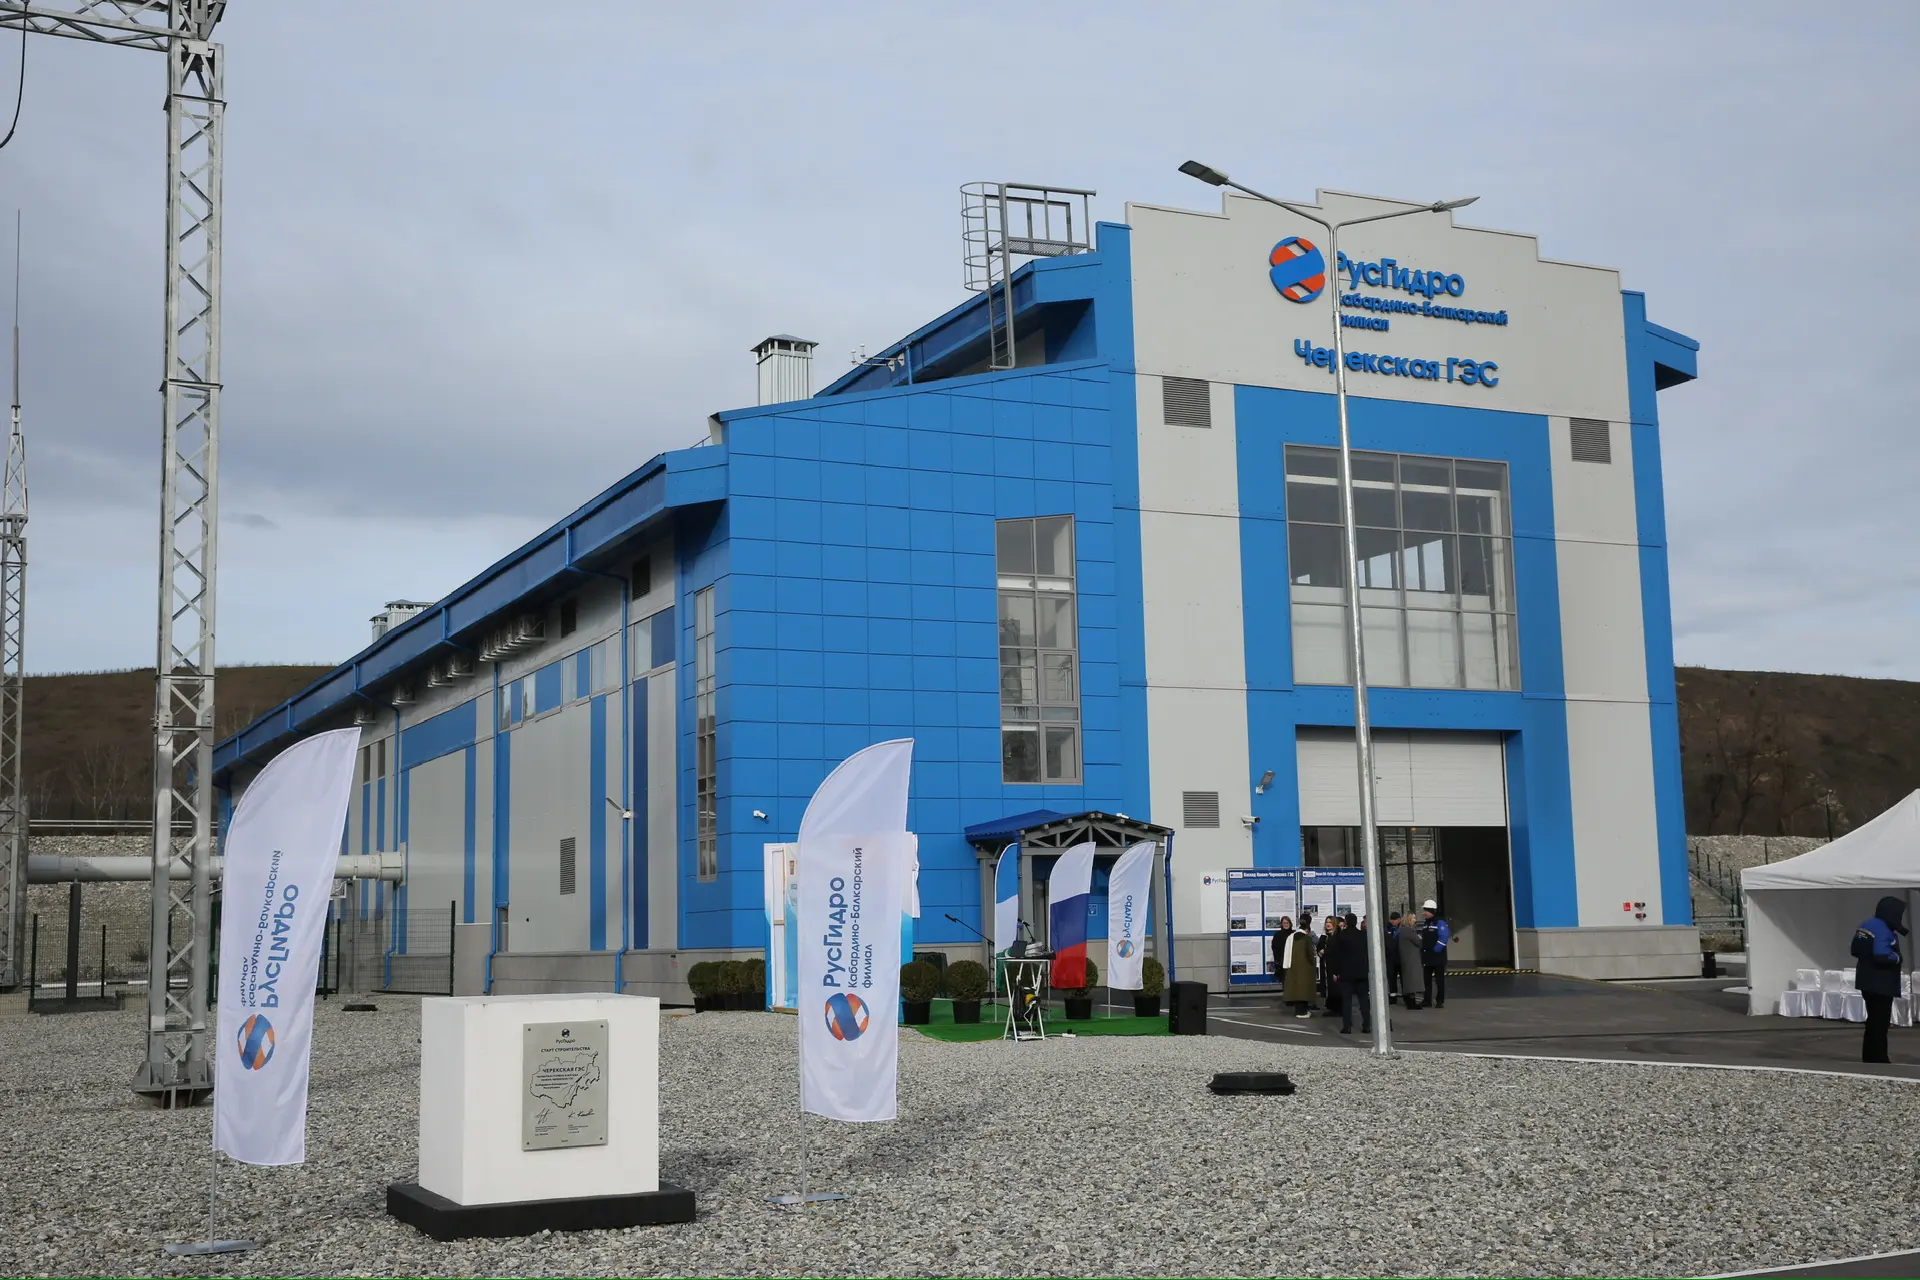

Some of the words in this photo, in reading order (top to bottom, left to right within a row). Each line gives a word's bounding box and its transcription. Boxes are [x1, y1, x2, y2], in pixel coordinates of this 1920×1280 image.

[1336, 250, 1465, 298] РусГидро
[1339, 290, 1508, 326] абардино-Балкарский
[1446, 357, 1500, 387] ГЭС
[823, 877, 848, 987] РусГидро
[848, 847, 863, 988] Кабардино-Балкарский
[862, 944, 873, 988] филиал
